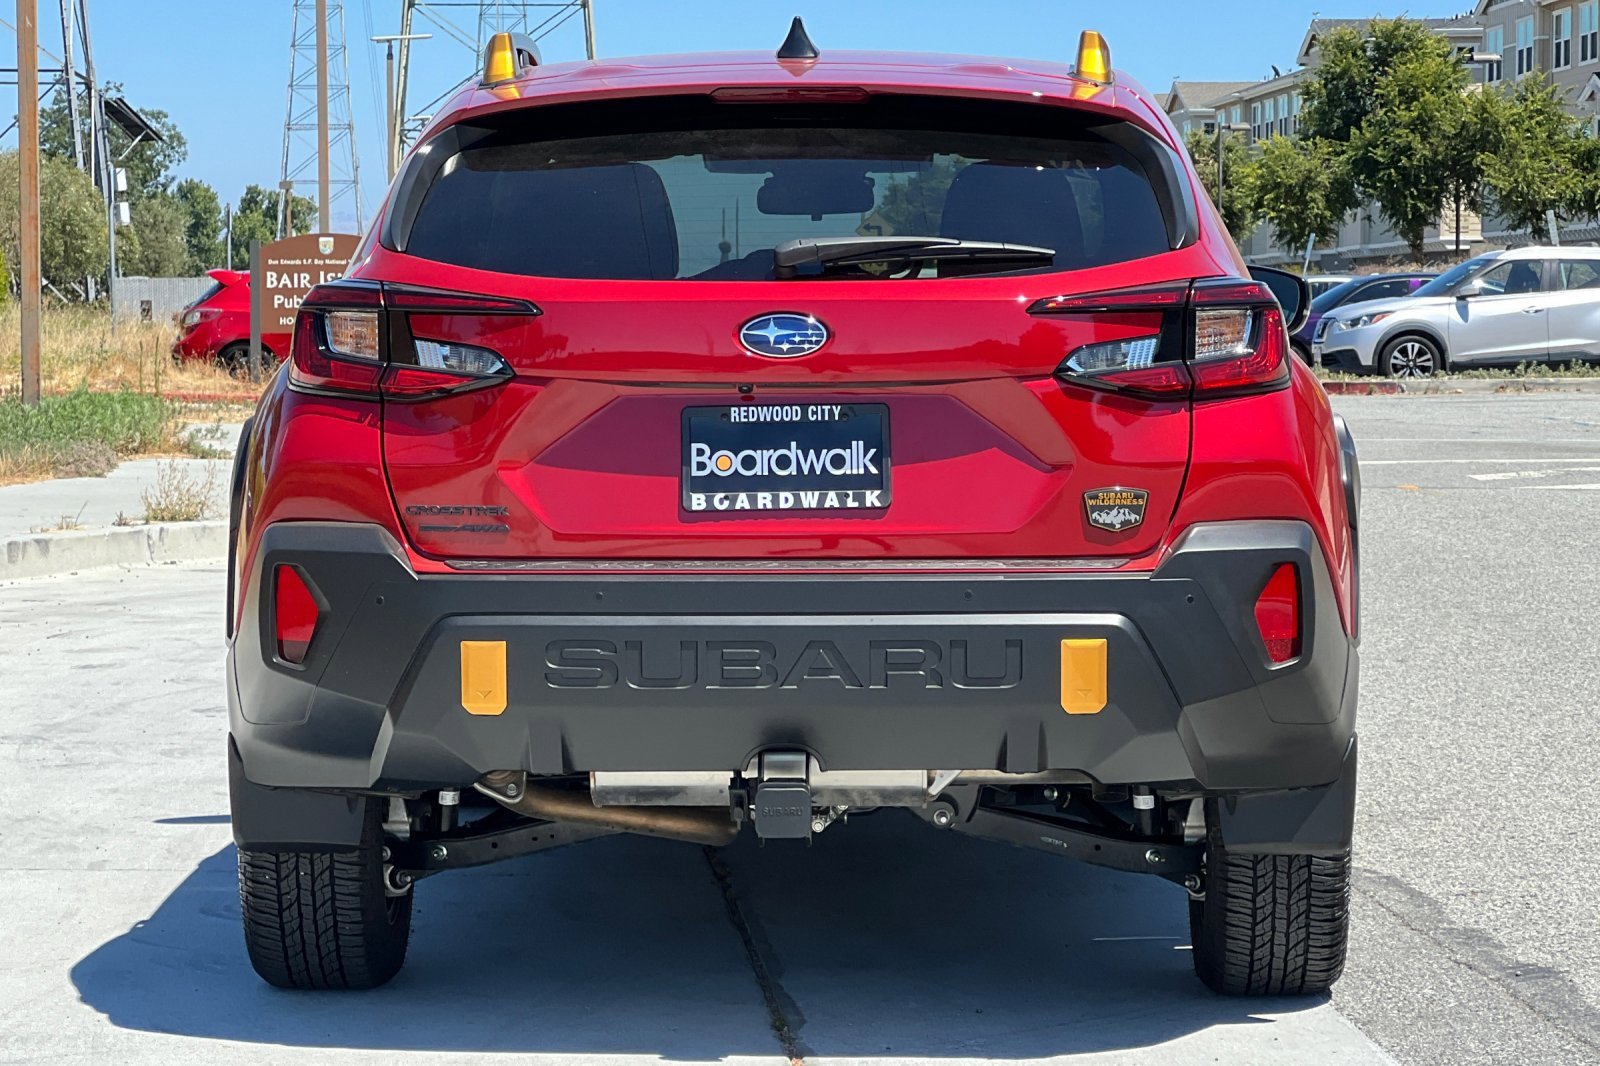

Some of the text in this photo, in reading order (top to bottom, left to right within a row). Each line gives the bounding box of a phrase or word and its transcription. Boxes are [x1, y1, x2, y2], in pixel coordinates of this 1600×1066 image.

[266, 271, 312, 289] BAIR
[730, 405, 841, 423] REDWOOD CITY
[690, 440, 879, 477] Boardwalk
[691, 490, 882, 511] BOARDWALK
[1087, 498, 1144, 506] WILDERNESS
[405, 505, 510, 517] CROSSTREK
[544, 638, 1024, 691] SUBARU
[762, 806, 803, 818] SUBARU
